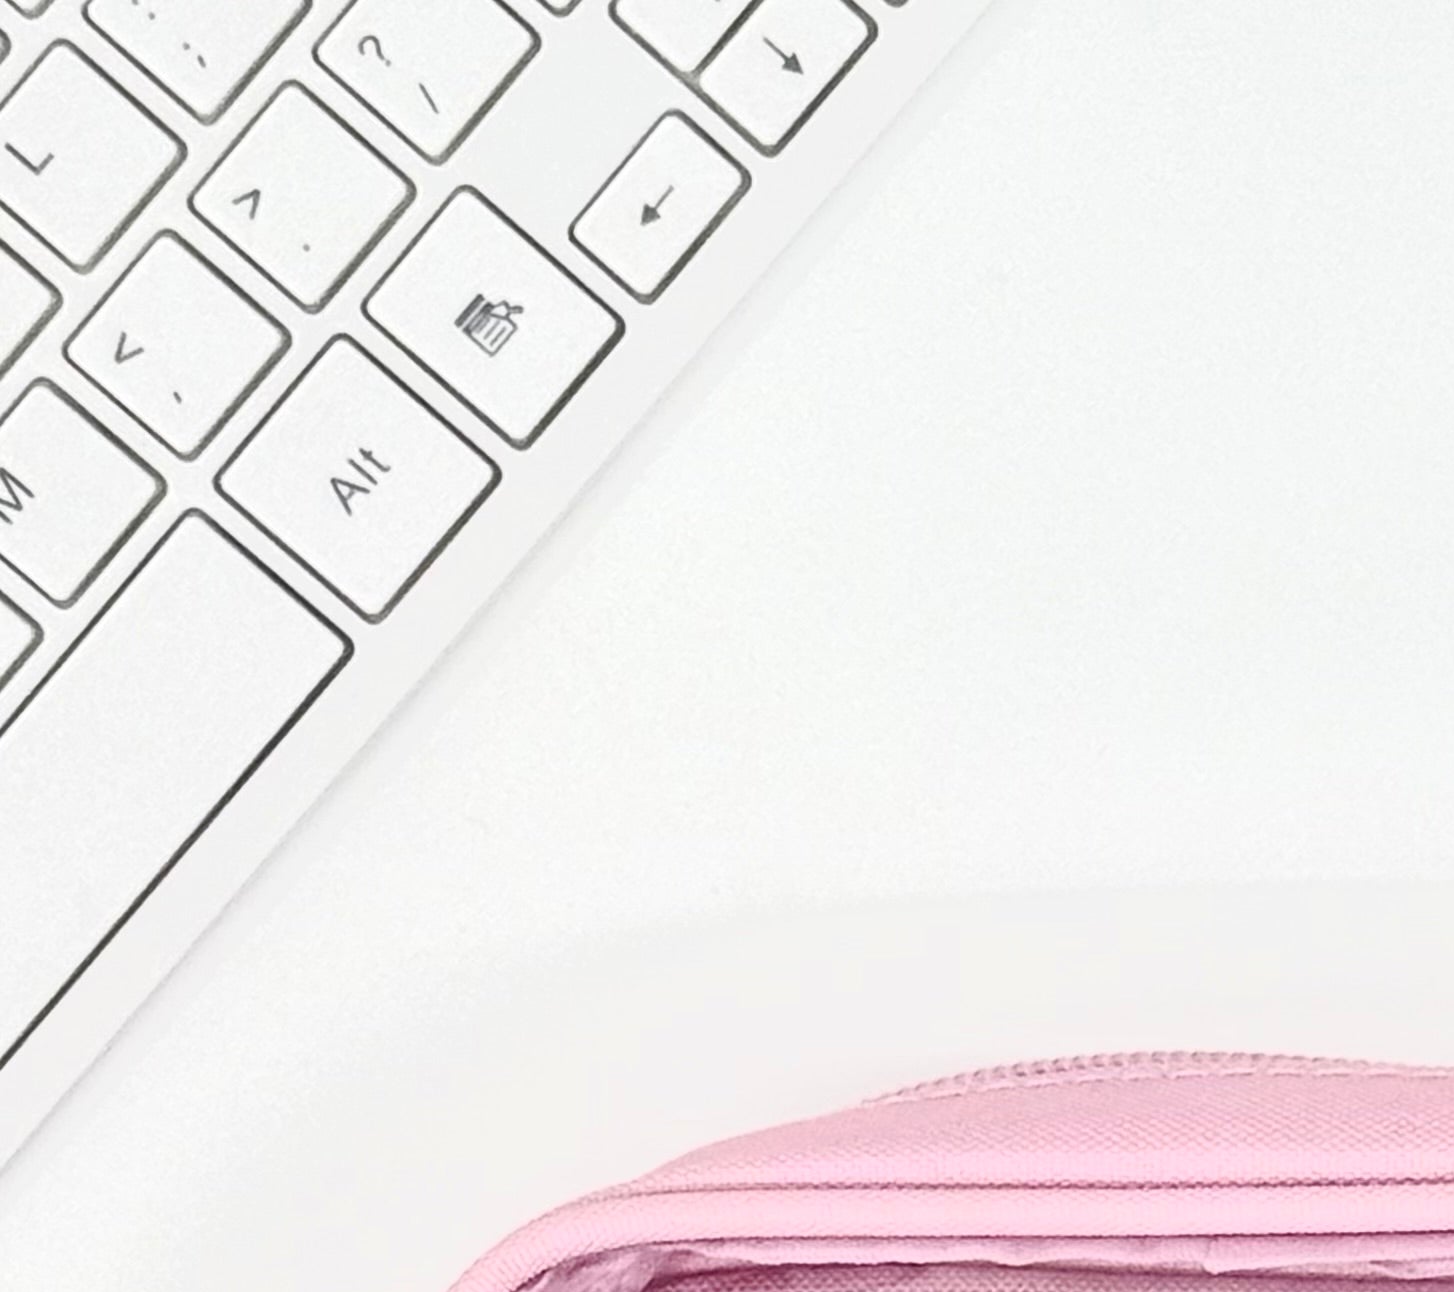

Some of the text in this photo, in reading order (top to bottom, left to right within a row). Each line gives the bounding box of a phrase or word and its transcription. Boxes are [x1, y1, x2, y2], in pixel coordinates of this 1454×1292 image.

[358, 35, 391, 67] ?
[4, 142, 54, 175] L
[329, 446, 391, 517] Alt
